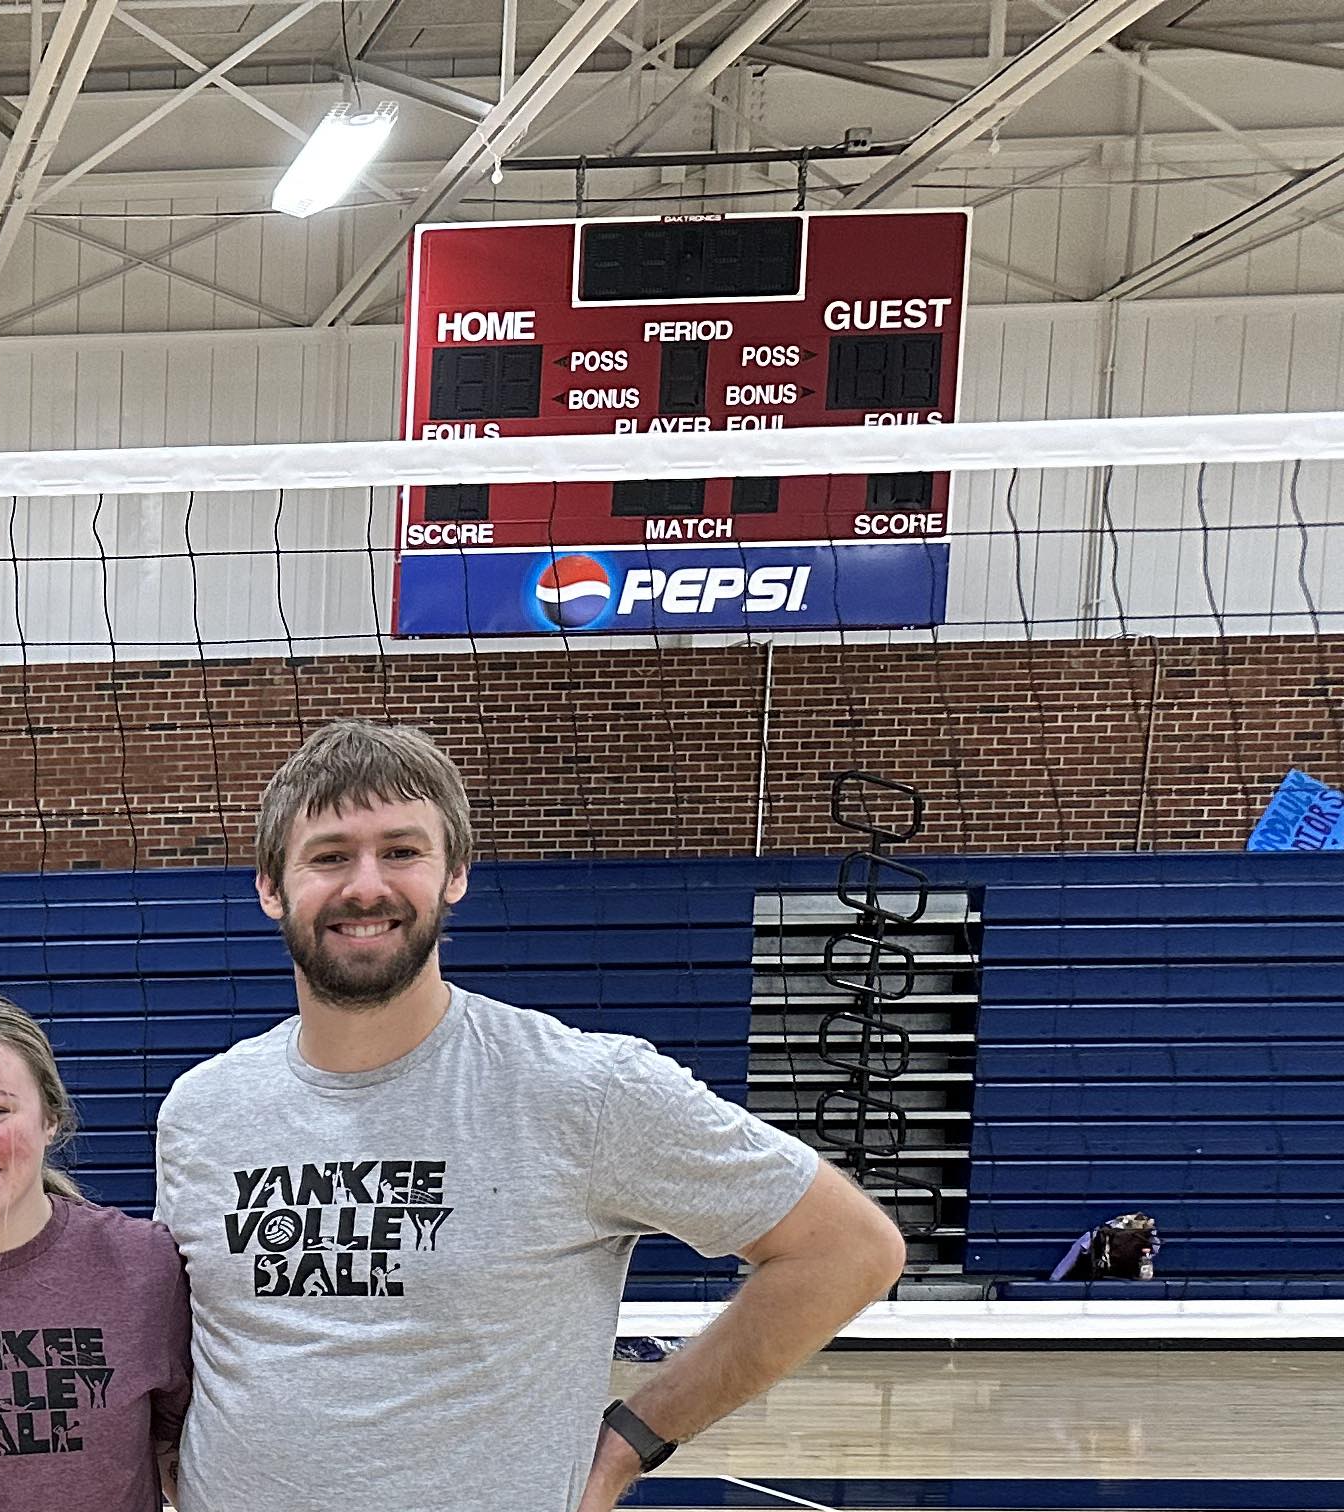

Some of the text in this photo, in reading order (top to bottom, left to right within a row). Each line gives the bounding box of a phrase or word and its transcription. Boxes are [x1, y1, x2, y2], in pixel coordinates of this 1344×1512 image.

[823, 299, 952, 331] GUEST
[437, 311, 535, 342] HOME
[644, 321, 733, 343] PERIOD
[570, 351, 628, 372] POSS
[742, 346, 801, 367] POSS
[568, 388, 640, 410] BONUS
[725, 384, 797, 405] BONUS
[615, 417, 711, 434] PLAYER
[408, 524, 494, 545] SCORE
[645, 518, 733, 540] MATCH
[854, 514, 943, 536] SCORE
[617, 566, 811, 614] PEPSI
[233, 1161, 446, 1210] YANKEE
[224, 1207, 454, 1254] VOLLEY
[254, 1252, 404, 1297] BALL
